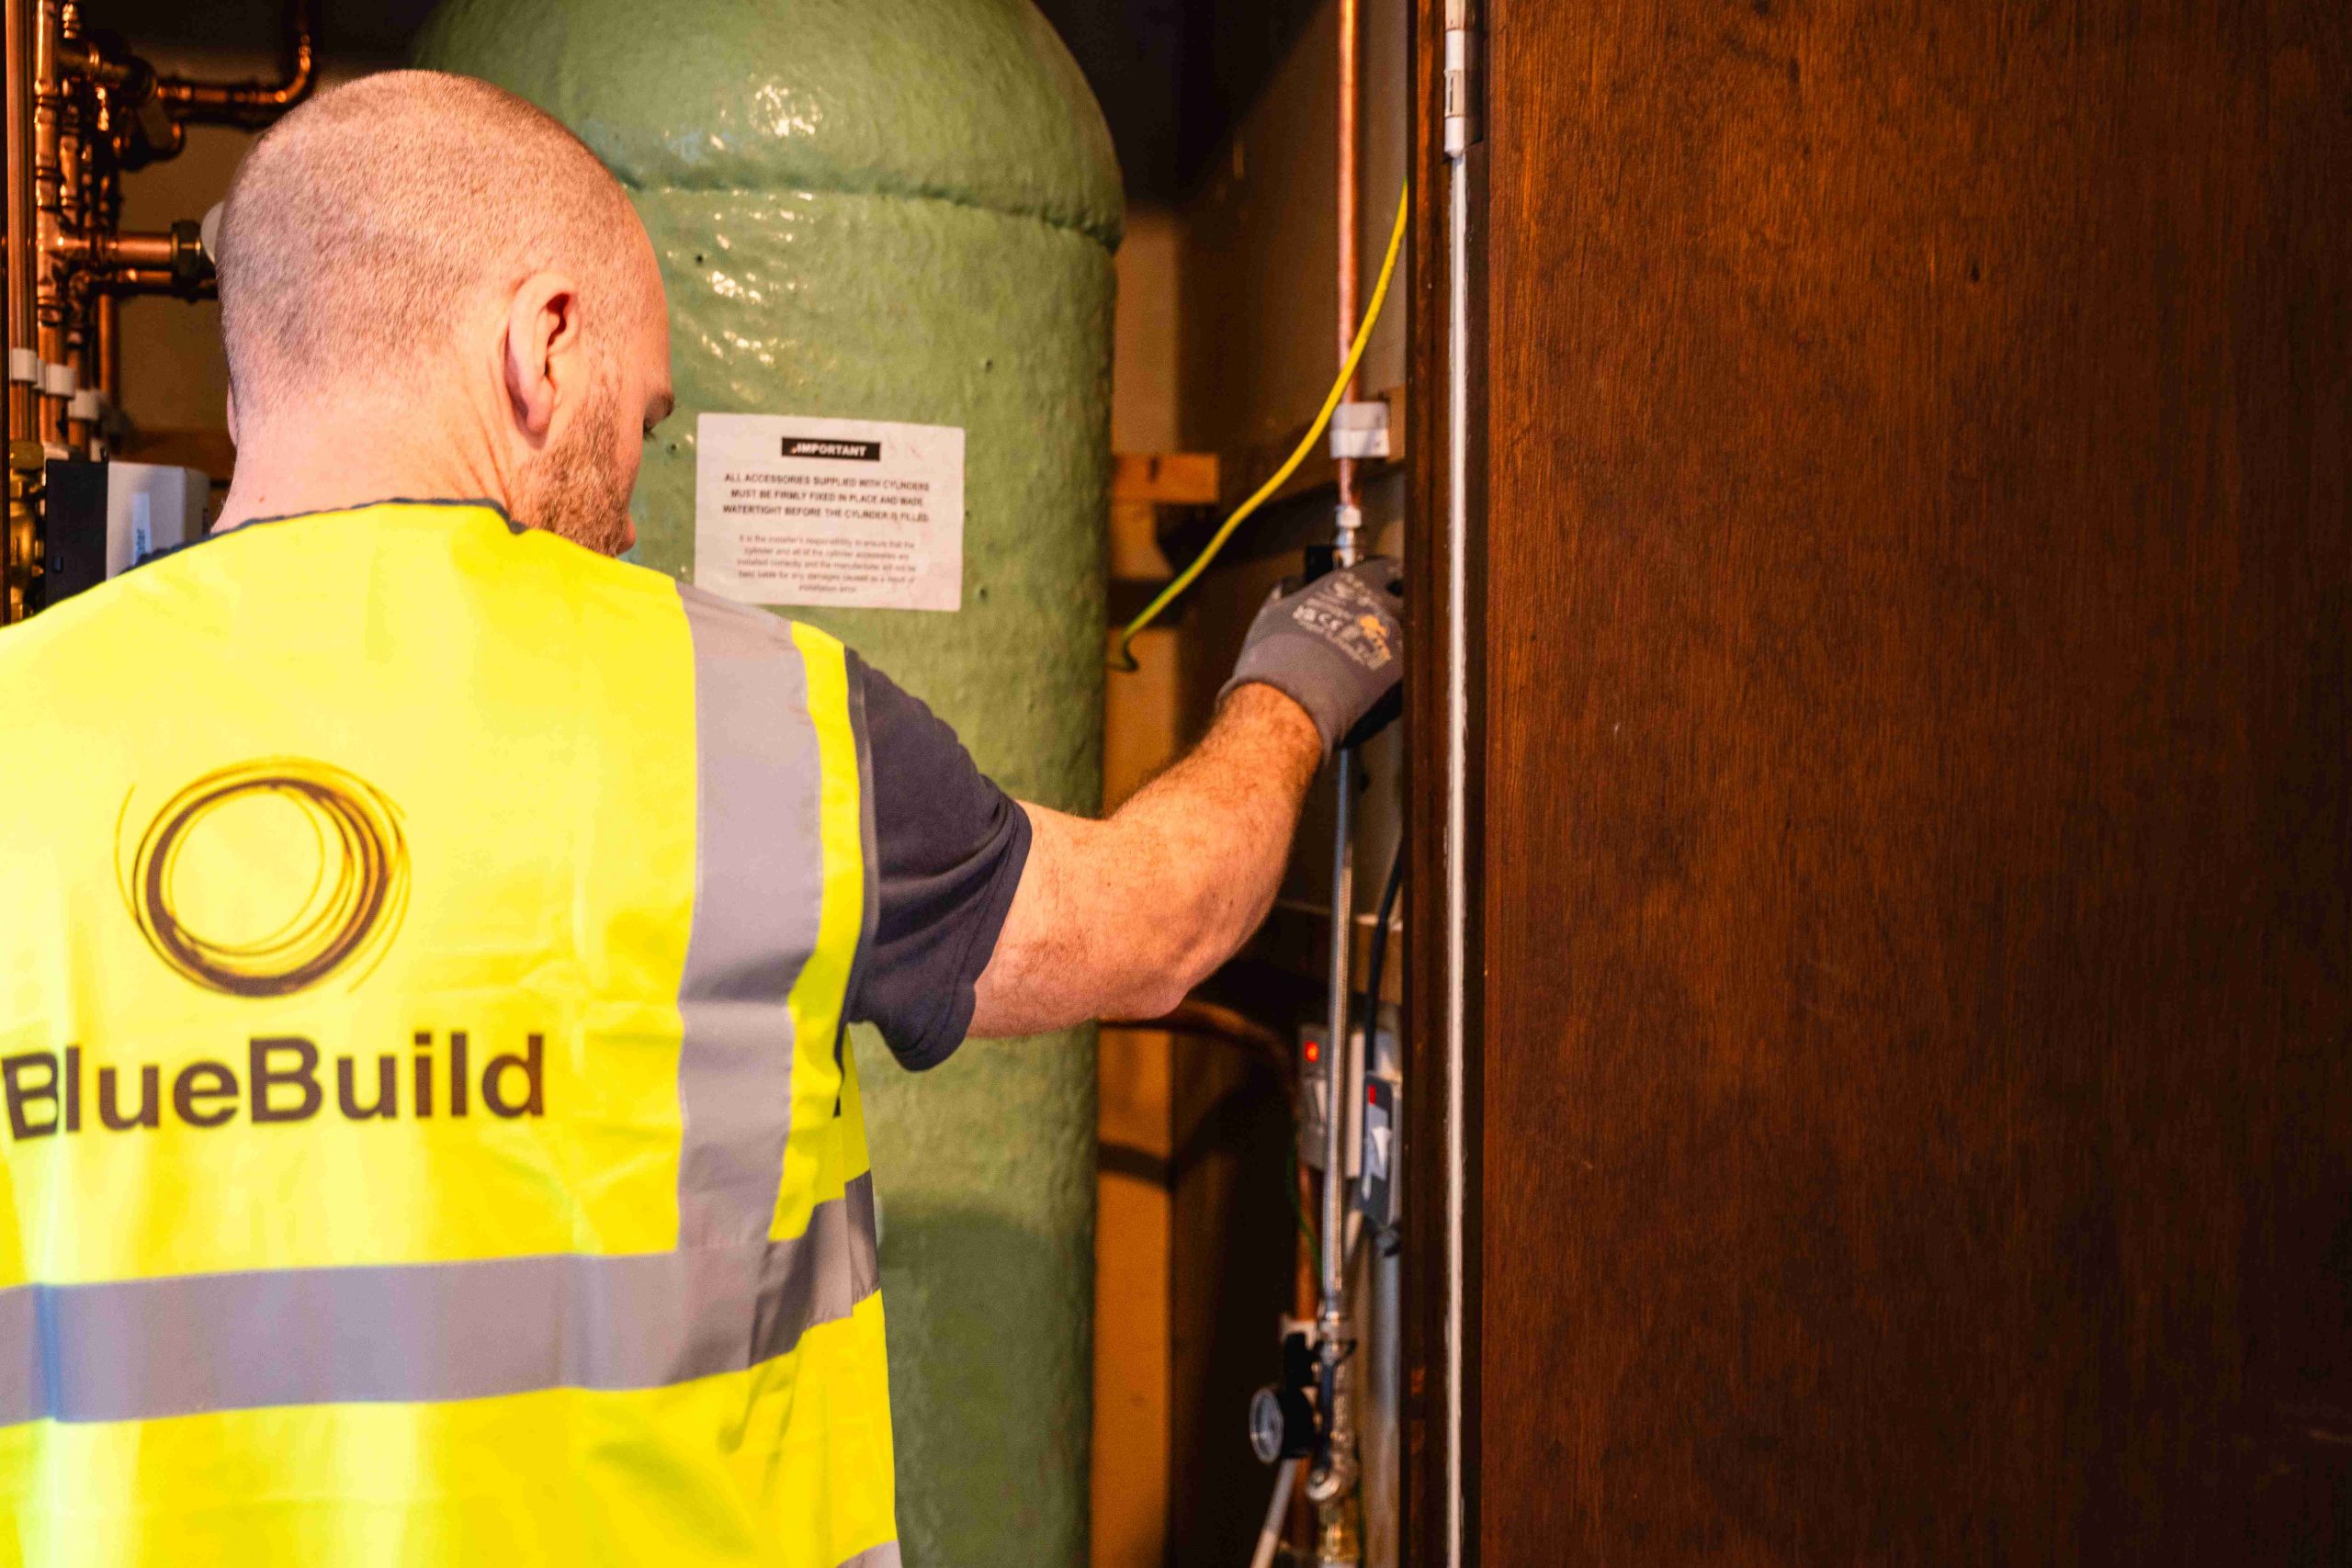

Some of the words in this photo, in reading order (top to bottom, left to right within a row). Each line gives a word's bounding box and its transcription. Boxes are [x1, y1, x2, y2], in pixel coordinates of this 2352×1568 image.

[796, 443, 867, 457] IMPORTANT
[725, 473, 741, 483] ALL
[745, 473, 810, 486] ACCESSORIES
[813, 476, 856, 489] SUPPLIED
[859, 479, 881, 489] WITH
[883, 479, 930, 492] CYLINDERS
[731, 490, 756, 499] MUST
[760, 490, 771, 499] BE
[775, 490, 807, 501] FIRMLY
[809, 491, 835, 502] FIXED
[839, 493, 846, 502] IN
[848, 494, 877, 505] PLACE
[880, 496, 898, 505] AND
[900, 497, 923, 508] MADE
[723, 504, 782, 515] WATERTIGHT
[785, 506, 821, 517] BEFORE
[825, 508, 842, 518] THE
[844, 509, 888, 520] CYLINDER
[1, 1031, 546, 1142] BlueBuild
